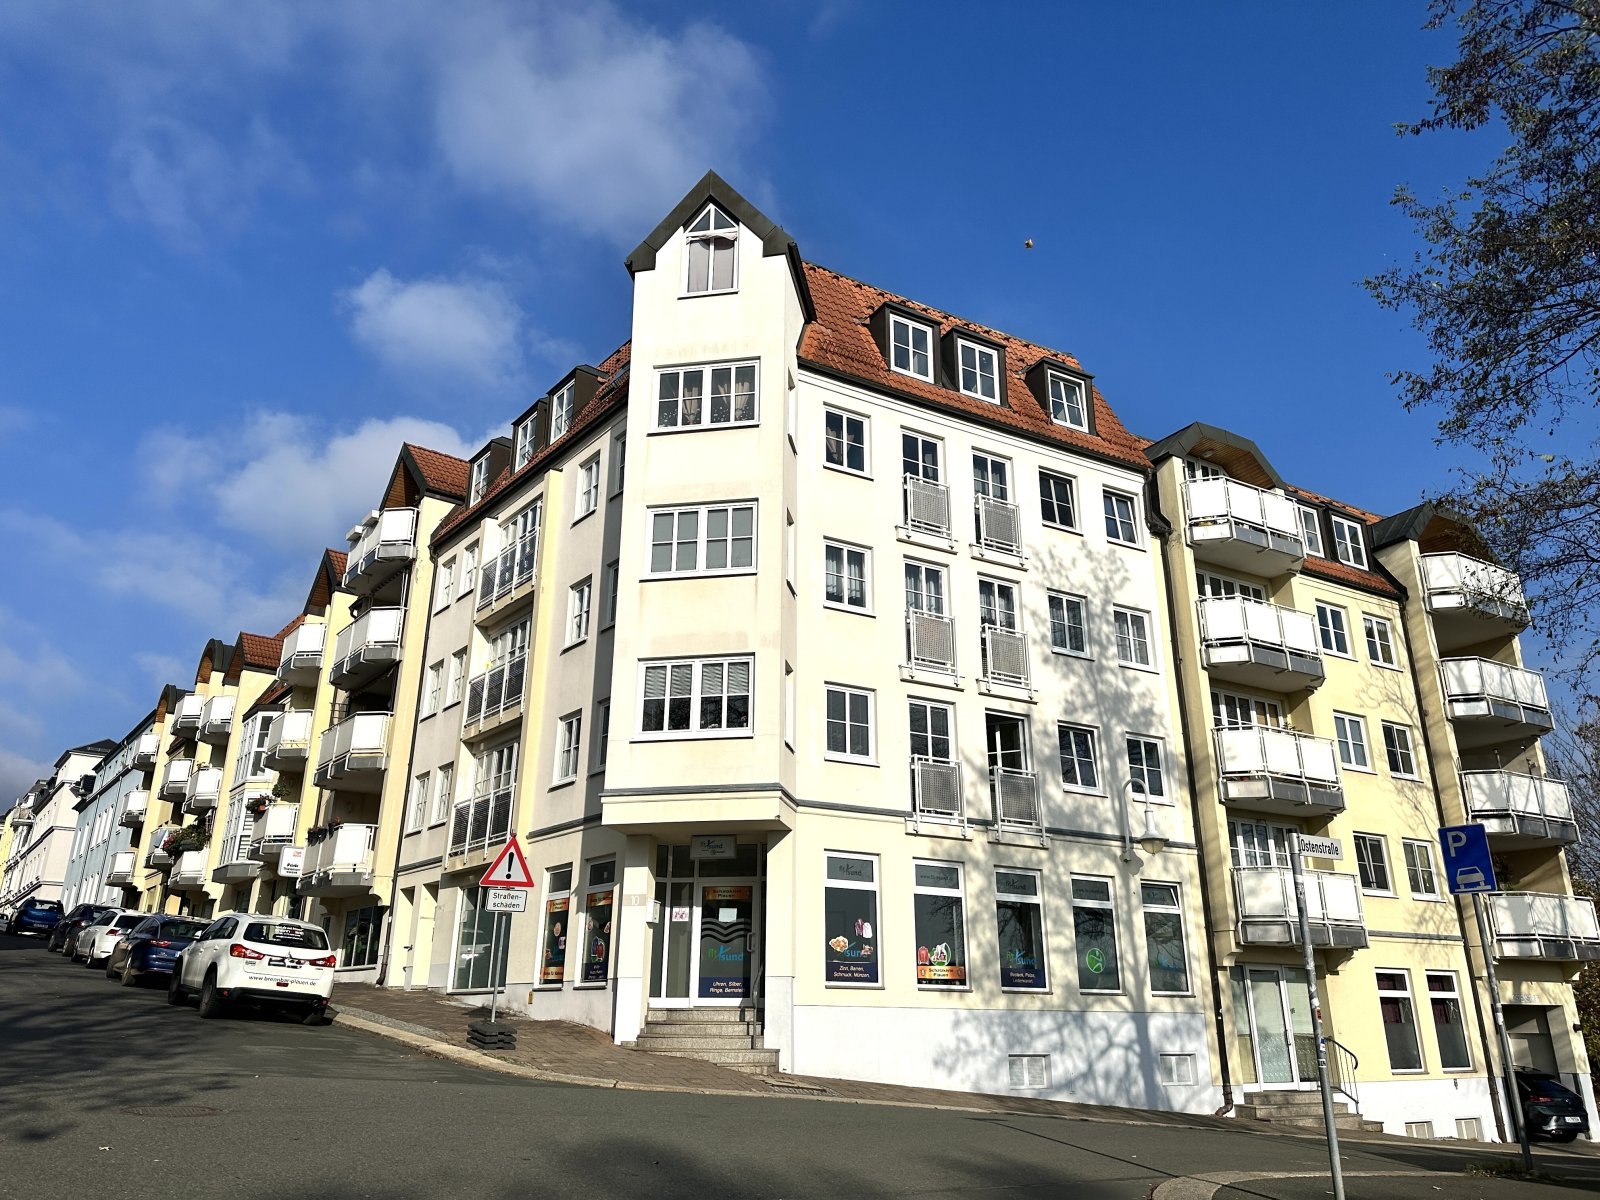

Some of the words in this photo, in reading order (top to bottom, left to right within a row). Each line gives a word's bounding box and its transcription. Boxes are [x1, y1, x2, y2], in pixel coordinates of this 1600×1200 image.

[1300, 838, 1340, 856] Ostenstraße
[1447, 830, 1467, 858] P
[492, 892, 523, 900] Straßen-
[631, 895, 640, 906] 10
